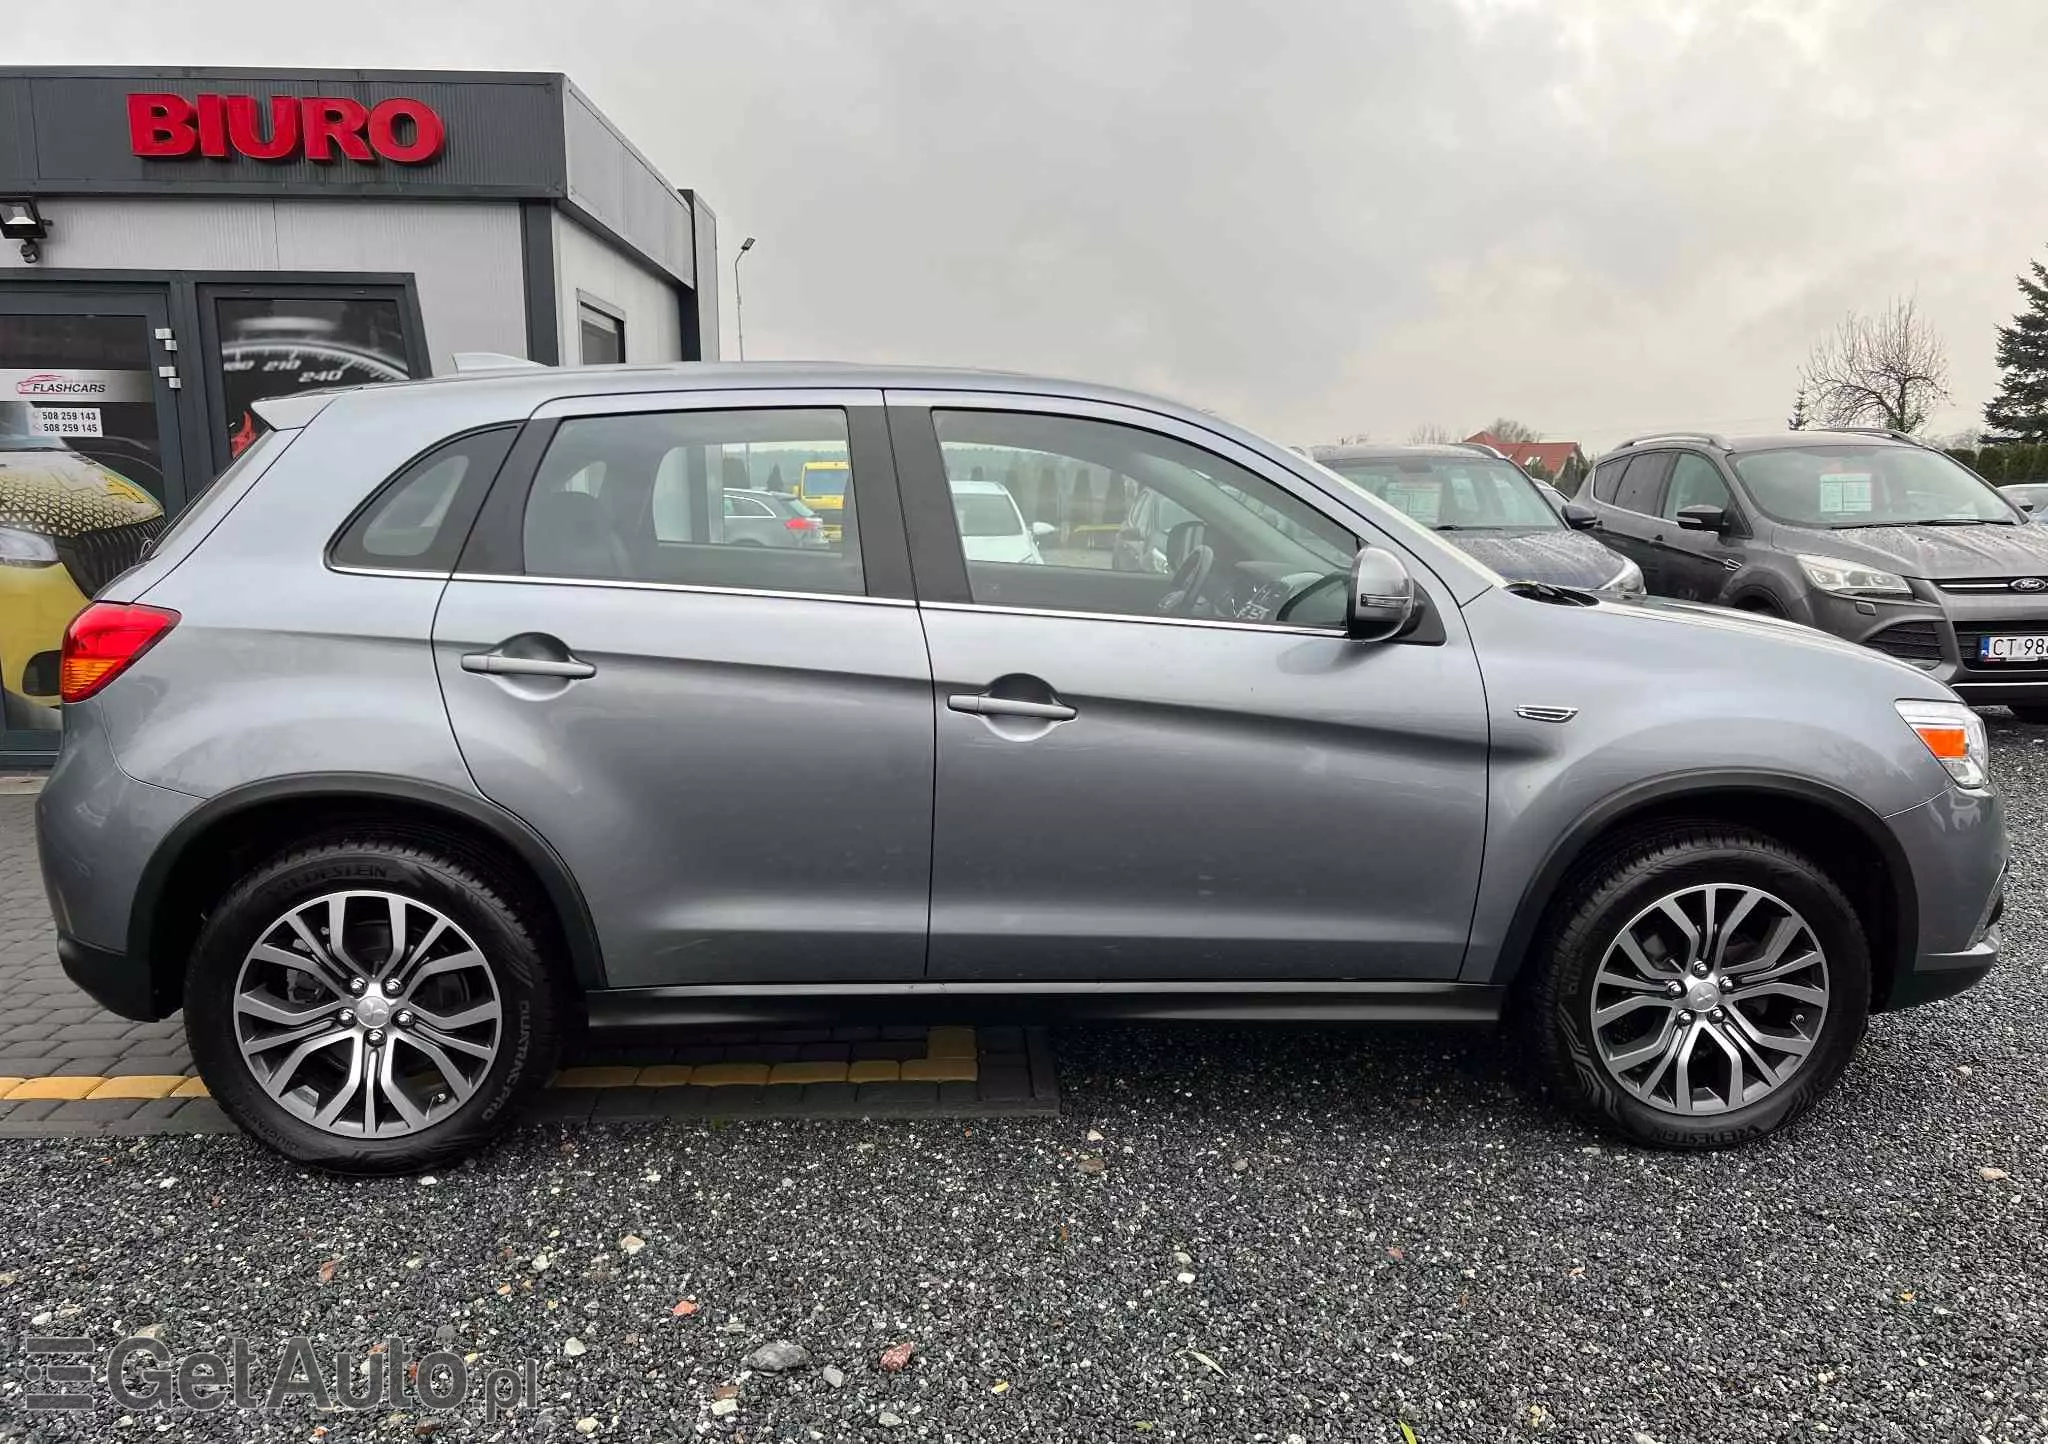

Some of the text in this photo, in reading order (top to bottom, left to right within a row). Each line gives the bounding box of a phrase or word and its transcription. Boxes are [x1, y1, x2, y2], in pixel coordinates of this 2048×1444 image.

[127, 93, 445, 164] BIURO
[299, 370, 343, 382] 240
[33, 383, 106, 393] FLASHCARS
[42, 411, 96, 421] 508 259 143
[43, 423, 97, 433] 508 259 145
[1993, 638, 2048, 656] CT 98
